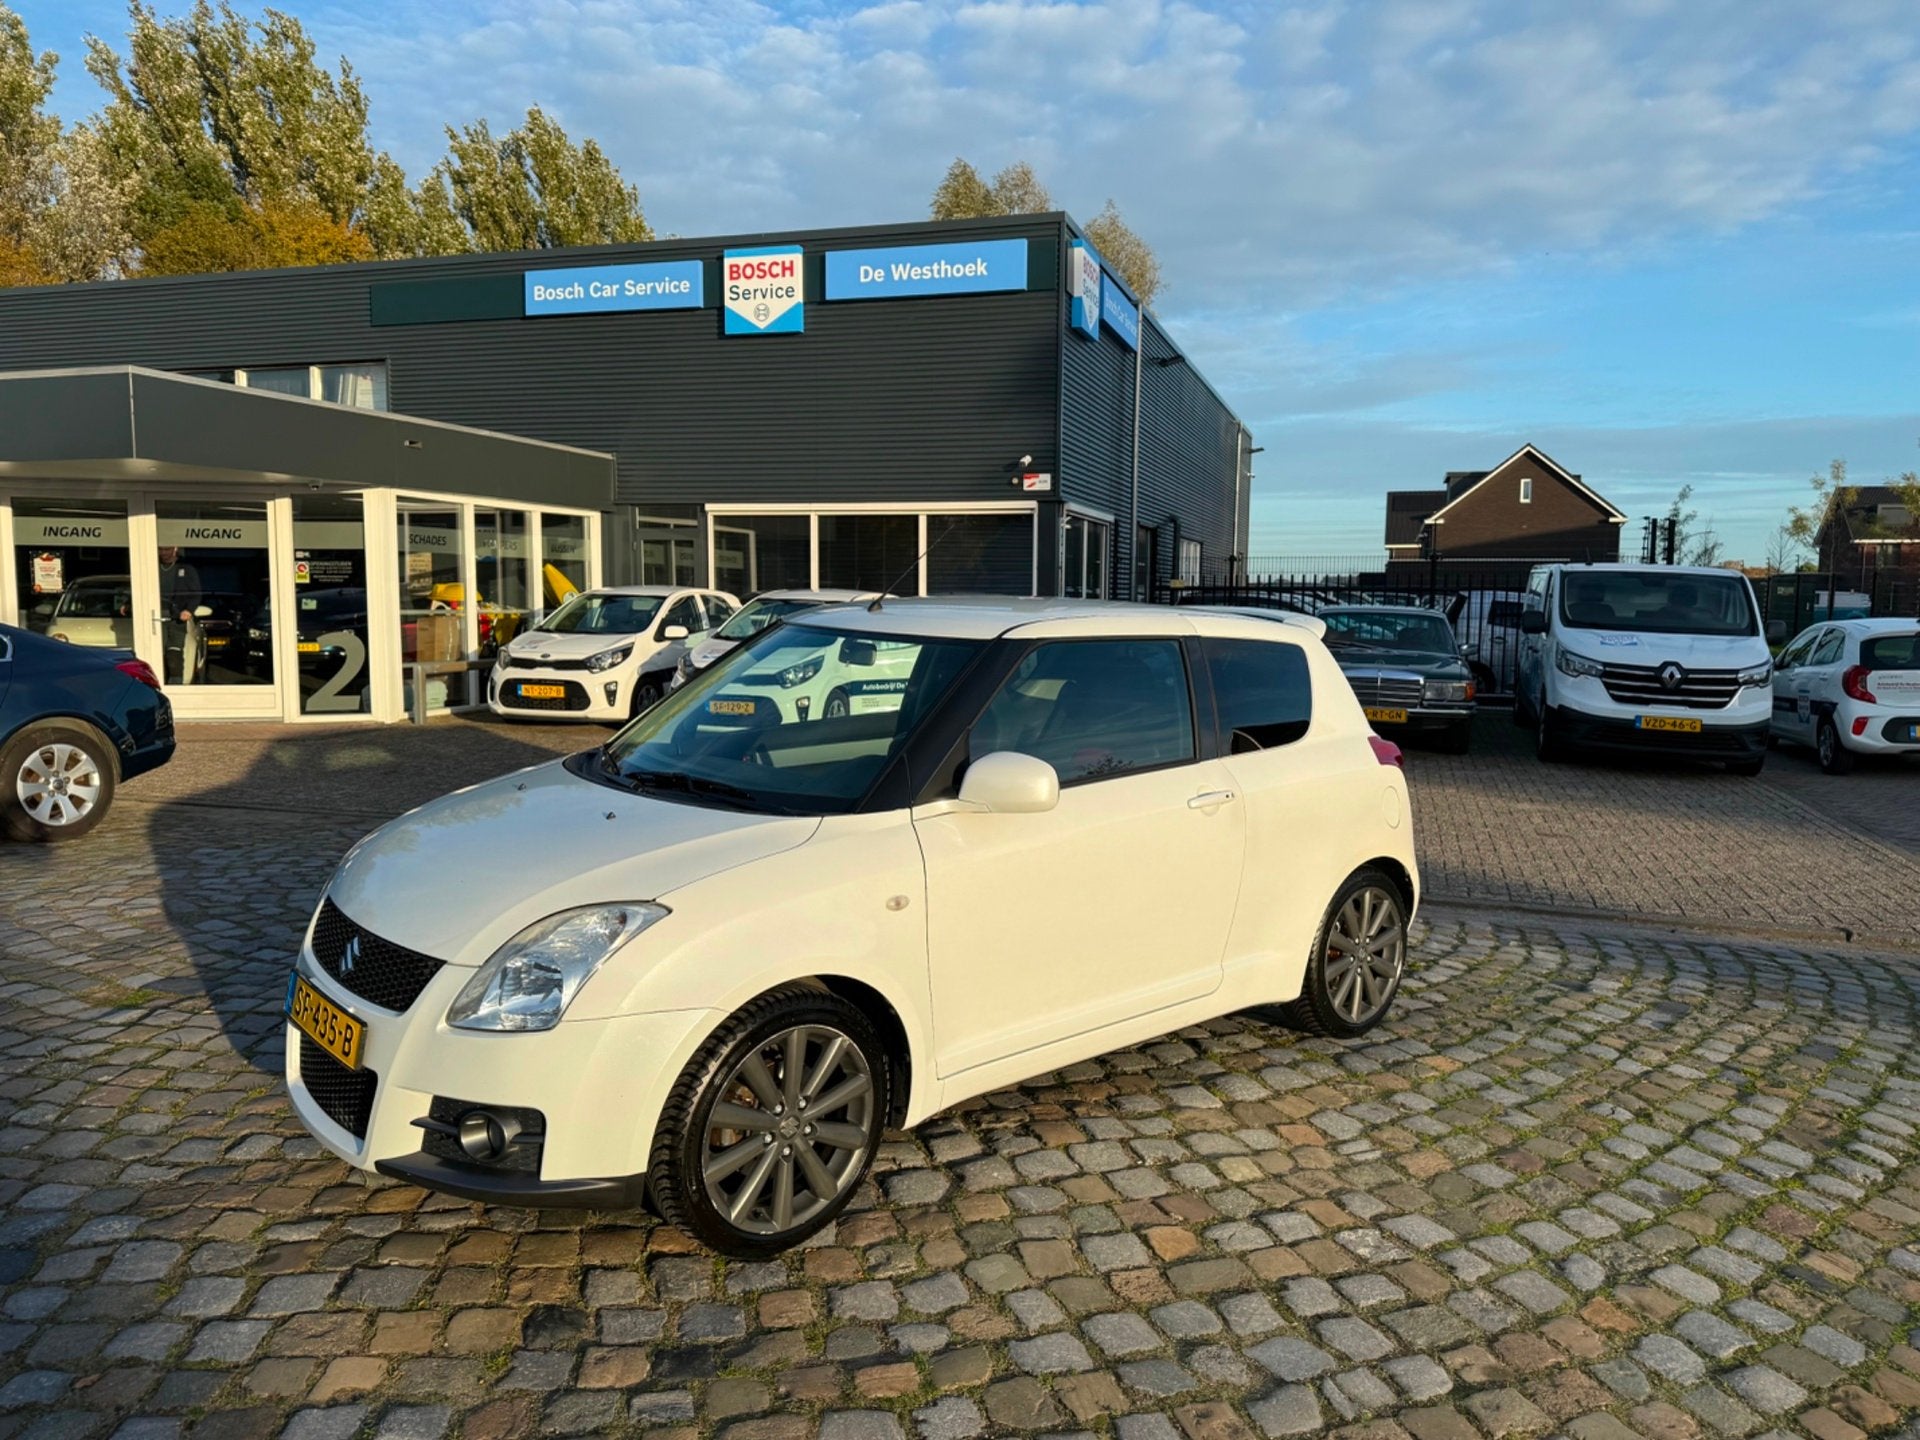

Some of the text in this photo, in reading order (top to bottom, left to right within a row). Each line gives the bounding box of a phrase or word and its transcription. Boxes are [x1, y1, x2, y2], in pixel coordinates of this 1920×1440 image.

[728, 260, 794, 281] BOSCH
[859, 258, 988, 283] De Westhoek
[533, 276, 690, 301] Bosch Car Service
[729, 283, 795, 301] Service
[43, 526, 102, 538] INGANG
[185, 528, 242, 539] INGANG
[305, 629, 365, 712] 2
[1645, 717, 1698, 730] VZD-46-G
[295, 985, 354, 1057] SF-435-B
